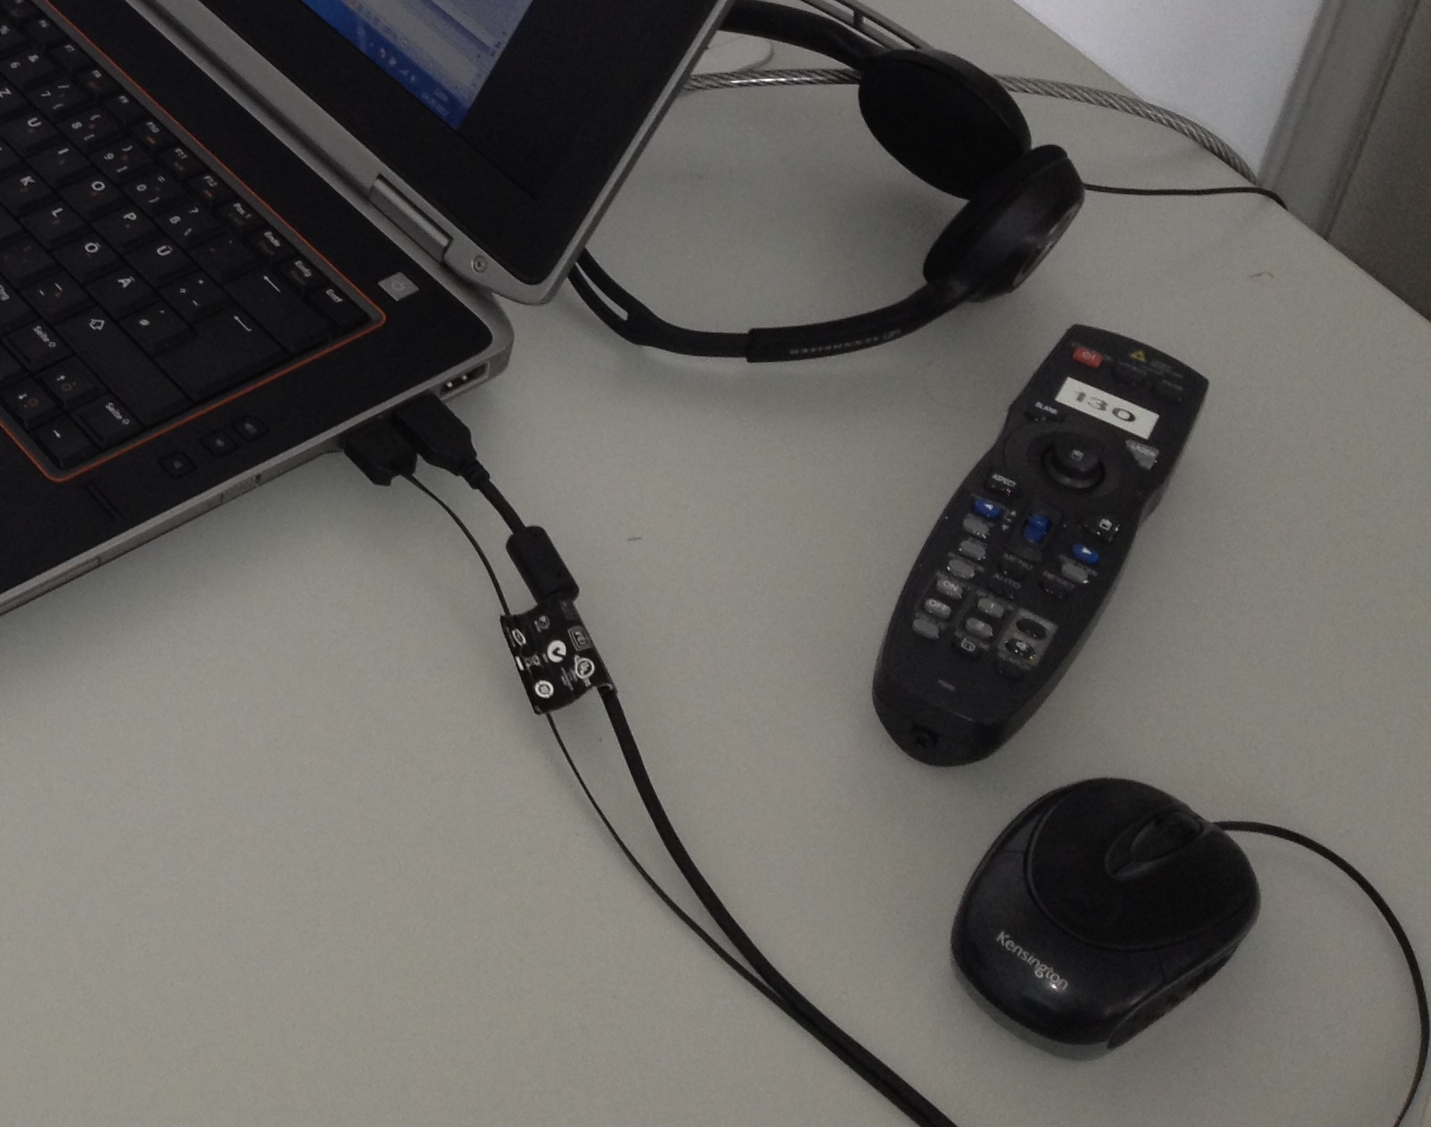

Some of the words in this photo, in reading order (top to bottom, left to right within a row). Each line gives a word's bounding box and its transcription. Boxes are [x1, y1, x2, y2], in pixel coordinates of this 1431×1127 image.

[27, 117, 42, 128] U
[20, 175, 36, 186] K
[91, 180, 106, 191] O
[51, 207, 64, 218] L
[123, 212, 137, 221] P
[1035, 401, 1058, 415] BLANK
[1074, 390, 1136, 423] 130
[1131, 443, 1157, 458] LASER
[992, 473, 1017, 487] ASPECT
[943, 580, 958, 591] ON
[996, 930, 1068, 991] Kensington
